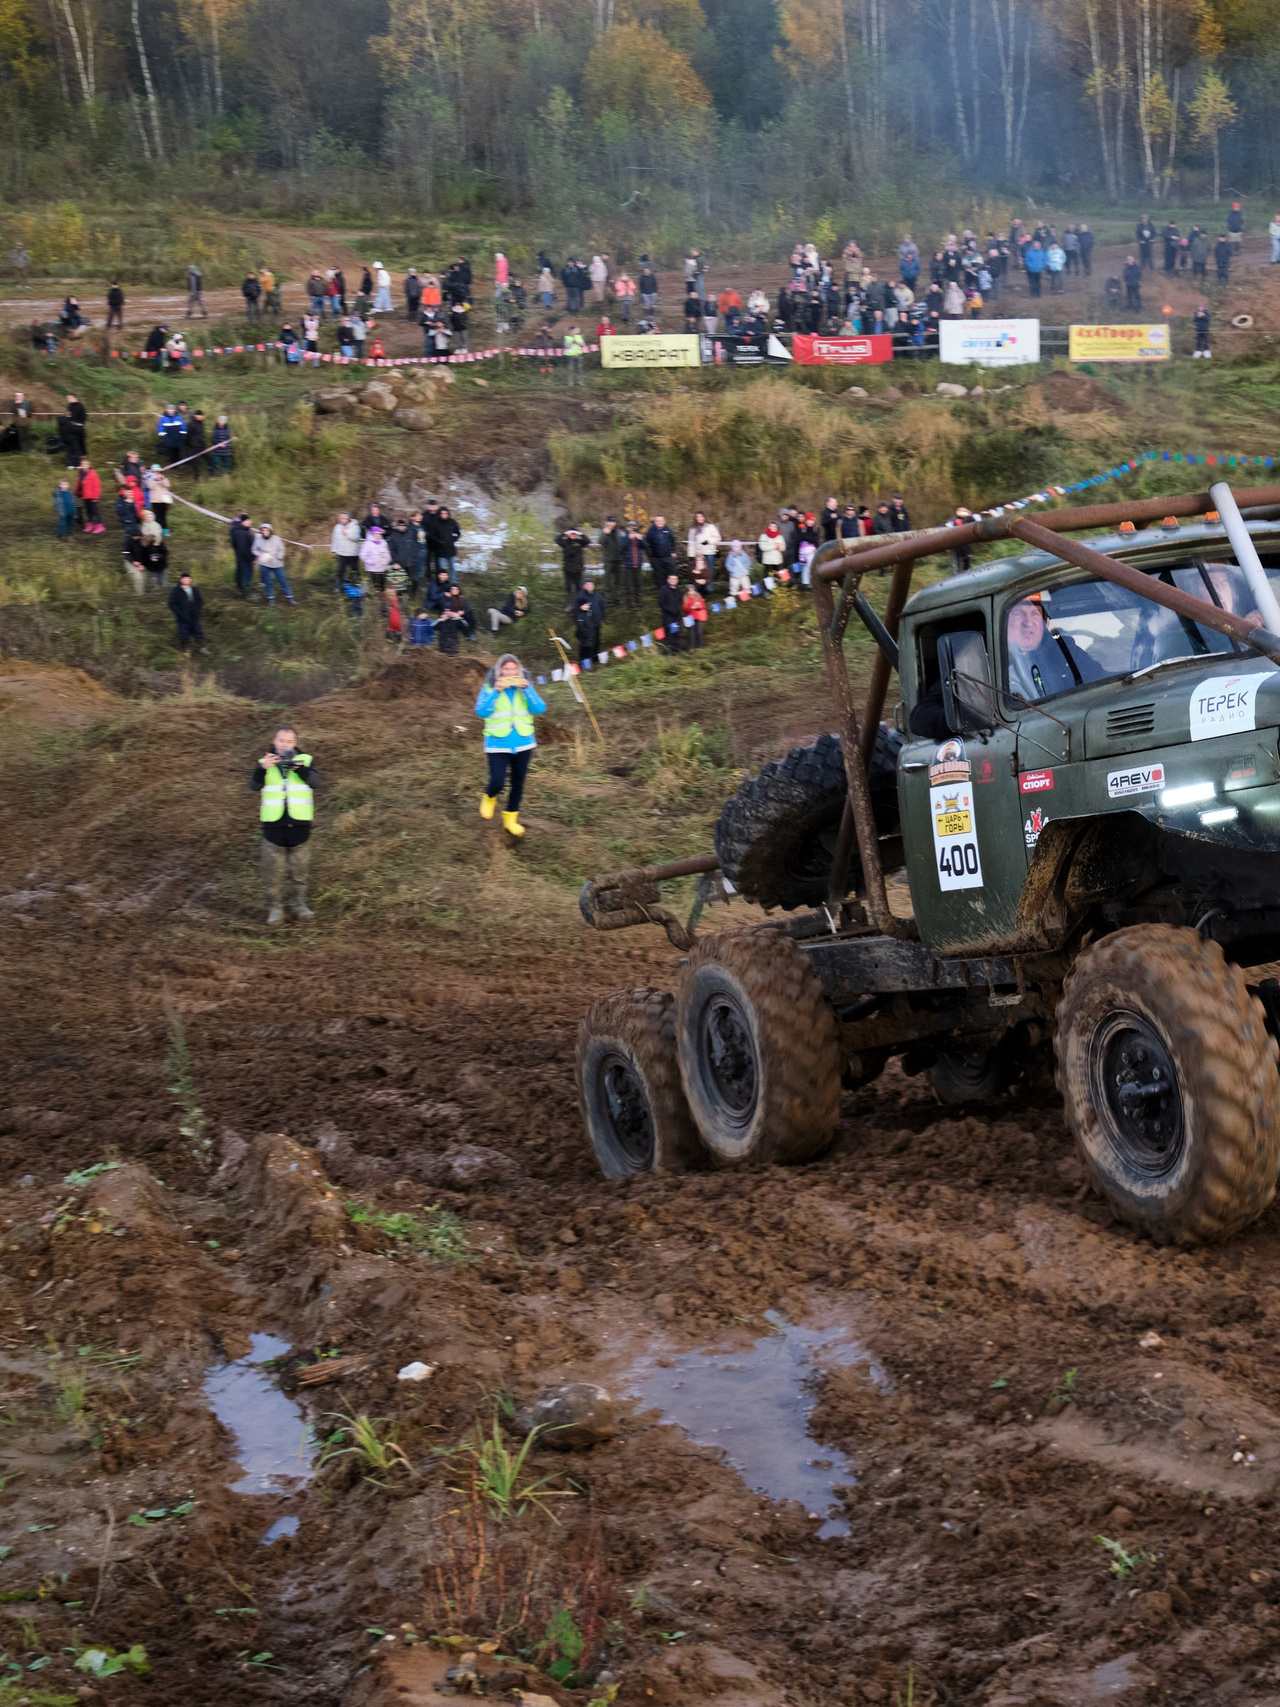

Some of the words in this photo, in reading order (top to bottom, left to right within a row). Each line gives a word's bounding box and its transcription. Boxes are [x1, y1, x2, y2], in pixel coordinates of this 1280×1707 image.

[611, 349, 690, 362] КВАДРАТ
[1198, 691, 1249, 715] ТЕРЕК
[1202, 710, 1245, 724] РАДИО
[1022, 779, 1050, 790] СПОРТ
[945, 814, 962, 824] ЦАРЬ
[945, 823, 965, 833] ГОРЫ
[940, 843, 979, 877] 400
